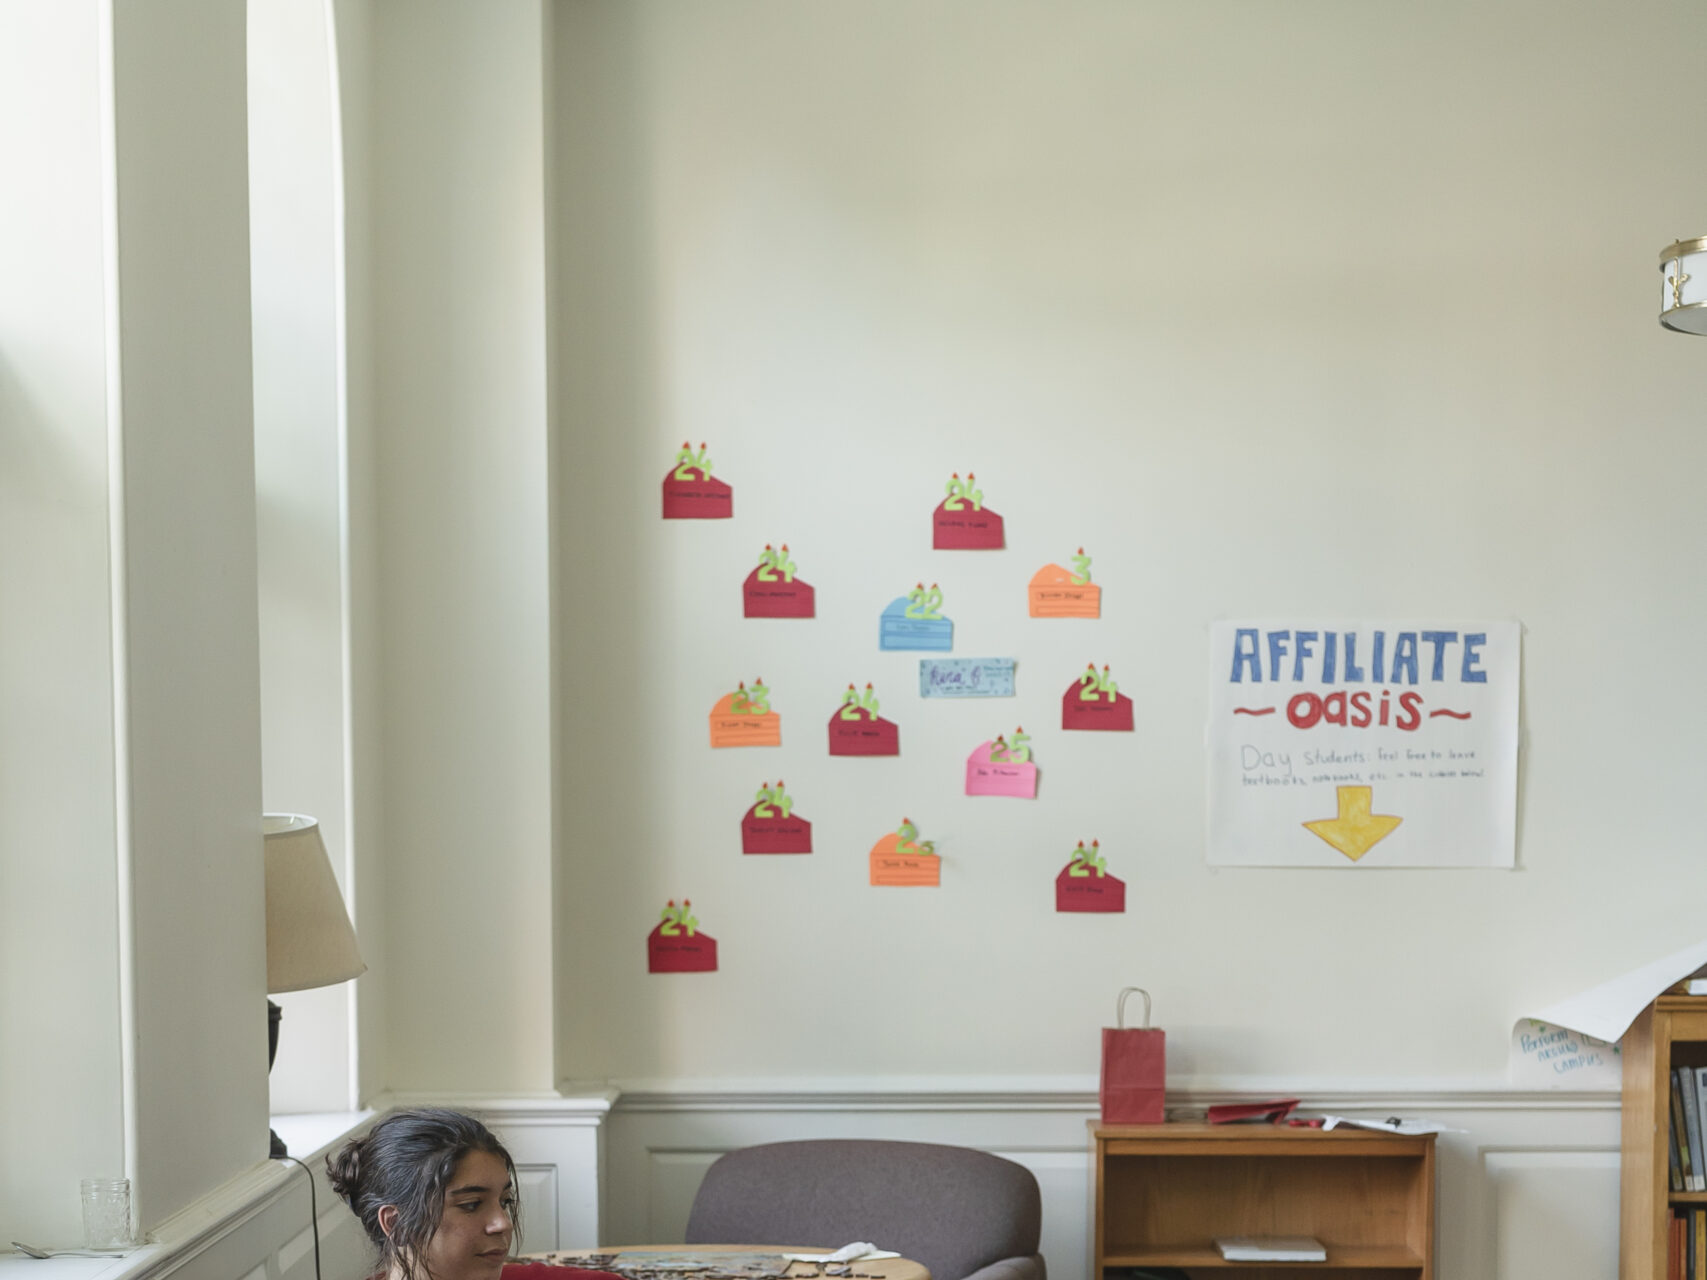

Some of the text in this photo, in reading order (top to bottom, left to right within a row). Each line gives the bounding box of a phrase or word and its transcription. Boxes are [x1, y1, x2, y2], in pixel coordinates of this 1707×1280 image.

[674, 448, 713, 482] 24
[945, 479, 984, 511] 24
[758, 550, 797, 583] 24
[905, 589, 944, 620] 22
[1230, 628, 1488, 685] AFFILIATE
[731, 684, 771, 715] 23
[1080, 670, 1118, 703] 24
[840, 689, 880, 721] 24
[989, 733, 1032, 765] 25
[1240, 744, 1292, 777] Day
[756, 787, 794, 818] 24
[1070, 847, 1109, 878] 24
[659, 907, 700, 937] 24
